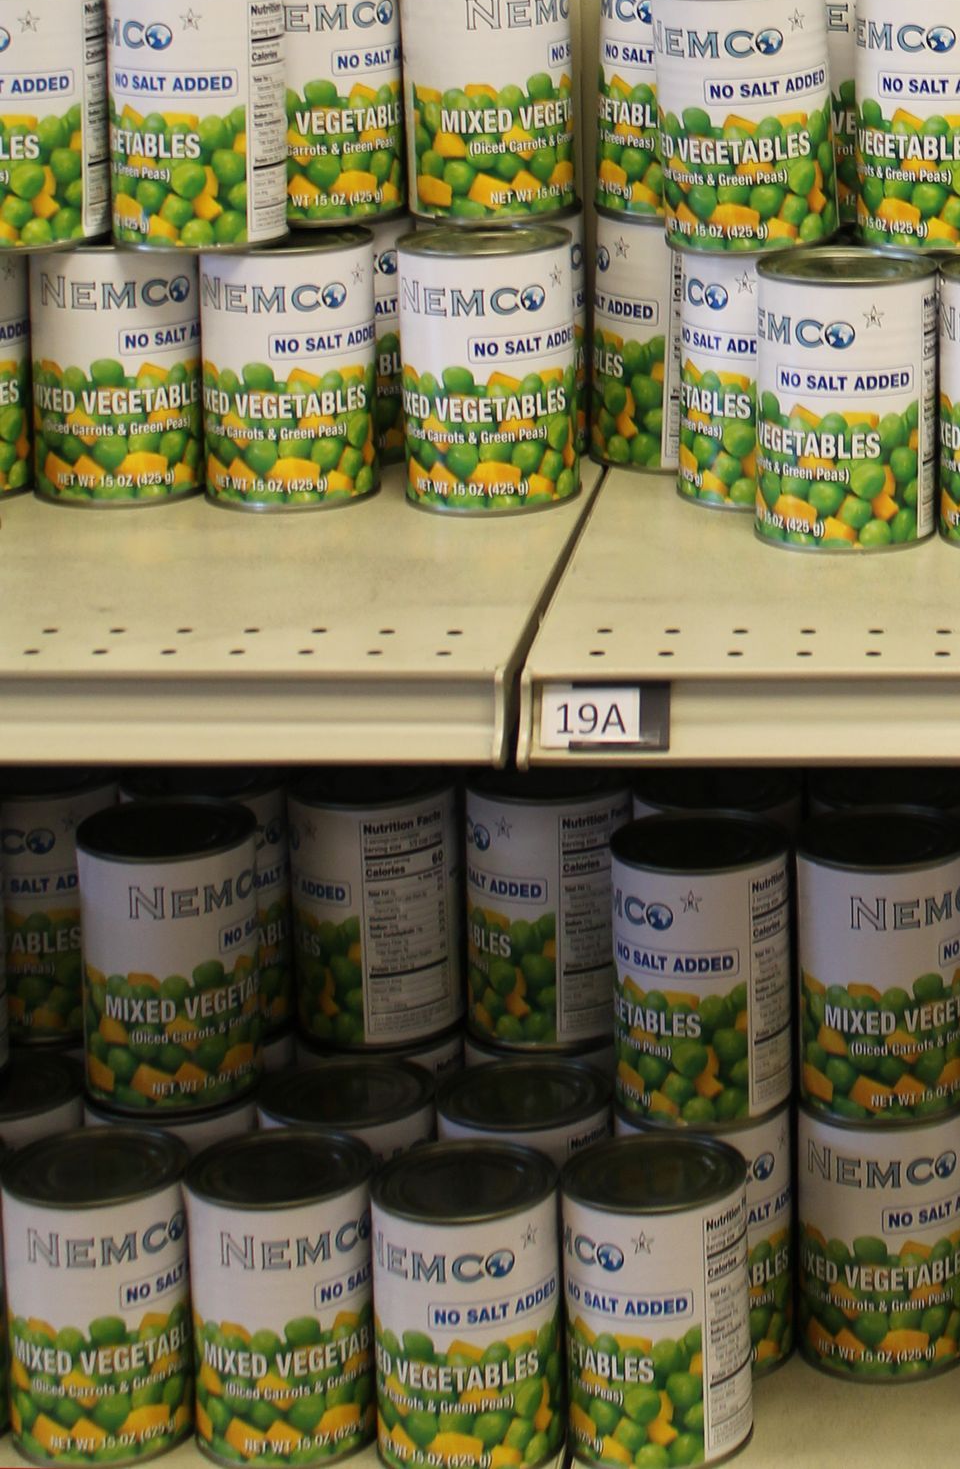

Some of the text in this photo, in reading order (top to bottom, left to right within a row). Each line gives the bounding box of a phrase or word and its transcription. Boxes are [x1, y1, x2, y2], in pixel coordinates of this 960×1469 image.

[132, 75, 233, 92] SALT ADDED
[710, 69, 824, 99] NO SALT ADDED
[882, 76, 903, 92] NO
[909, 79, 949, 95] SALT
[441, 109, 512, 134] MIXED
[678, 132, 811, 166] VEGETABLES
[718, 169, 788, 186] Green Peas)
[40, 272, 190, 311] NEMCO
[203, 273, 347, 314] NEMCO
[402, 278, 546, 317] NEMCO
[607, 302, 653, 320] ADDED
[124, 328, 186, 349] NO SALT
[274, 335, 342, 354] NO SALT
[474, 338, 541, 358] NO SALT
[781, 371, 910, 391] NO SALT ADDED
[235, 385, 367, 419] VEGETABLES
[435, 387, 566, 423] VEGETABLES
[72, 422, 164, 437] Carrots Green
[428, 425, 548, 444] Carrots Green Peas)
[782, 465, 851, 484] Green Peas)
[556, 702, 626, 734] 19A
[365, 864, 405, 878] Calories
[489, 878, 542, 899] ADDED
[633, 953, 734, 973] SALT ADDED
[105, 994, 176, 1024] MIXED
[824, 1004, 897, 1036] MIXED
[807, 1138, 957, 1189] NEMCO
[433, 1276, 556, 1326] NO SALT ADDED
[624, 1296, 688, 1317] ADDED
[204, 1340, 268, 1377] MIXED
[396, 1350, 539, 1393] VEGETABLES
